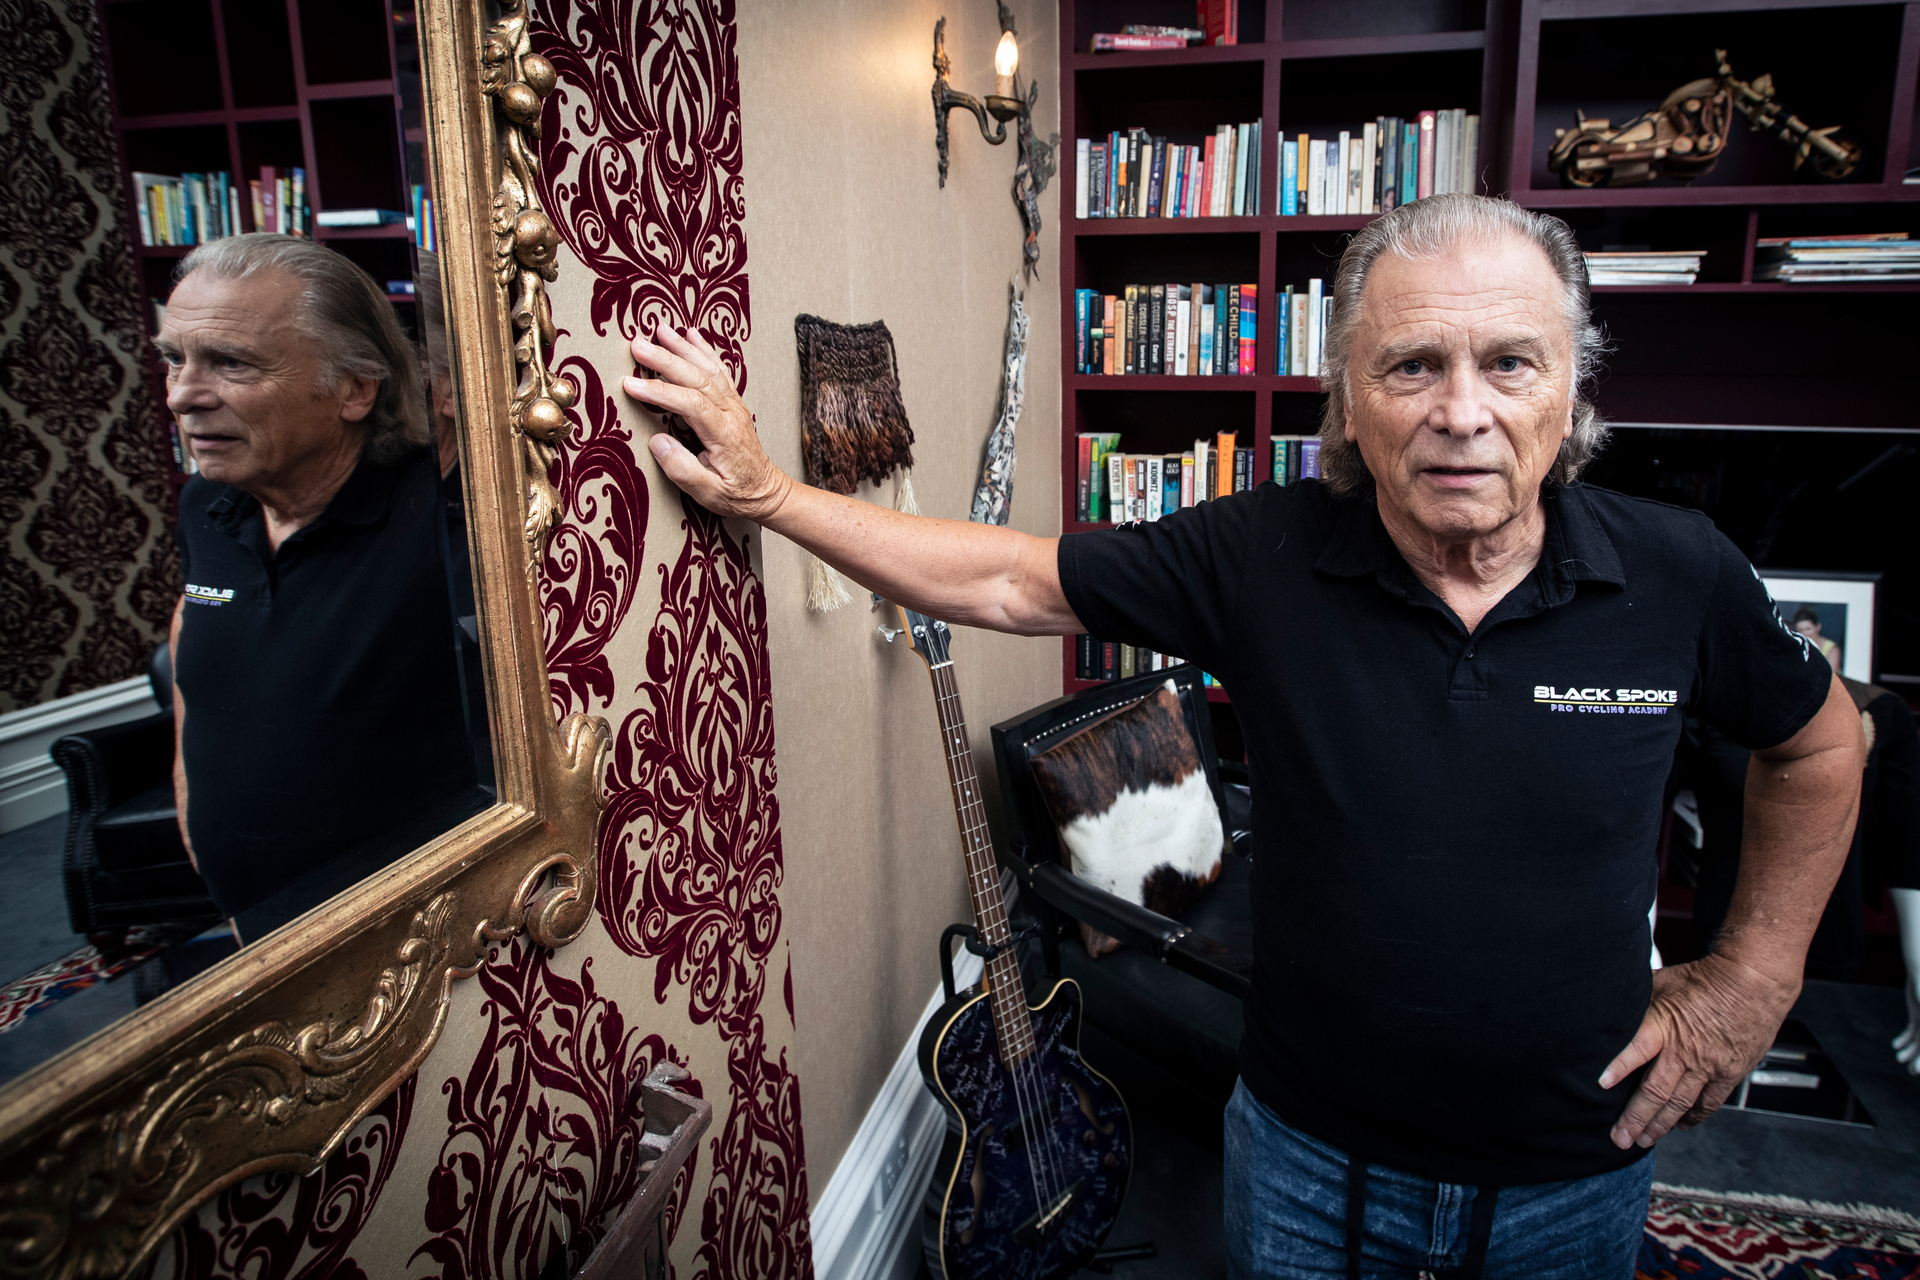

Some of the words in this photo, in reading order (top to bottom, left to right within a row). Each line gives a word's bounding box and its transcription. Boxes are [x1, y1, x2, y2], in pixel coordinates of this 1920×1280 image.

[1229, 285, 1239, 305] LEE
[1127, 300, 1135, 316] David
[1152, 304, 1160, 333] CUSSLER
[1126, 315, 1135, 339] Baldacci
[1139, 306, 1147, 335] CUSSLER
[1167, 319, 1175, 331] THE
[1229, 306, 1239, 339] CHILD
[1166, 331, 1175, 362] BETRAYED
[1276, 443, 1285, 462] LEE
[1112, 459, 1120, 484] ARCHER
[1150, 465, 1158, 493] KOONTZ
[1127, 476, 1135, 498] KOONTZ
[1534, 685, 1612, 701] BLACK
[1616, 689, 1678, 703] SPOKE
[1550, 703, 1574, 713] PRO
[1578, 705, 1625, 714] CYCLING
[1628, 706, 1668, 715] ACADEMY
